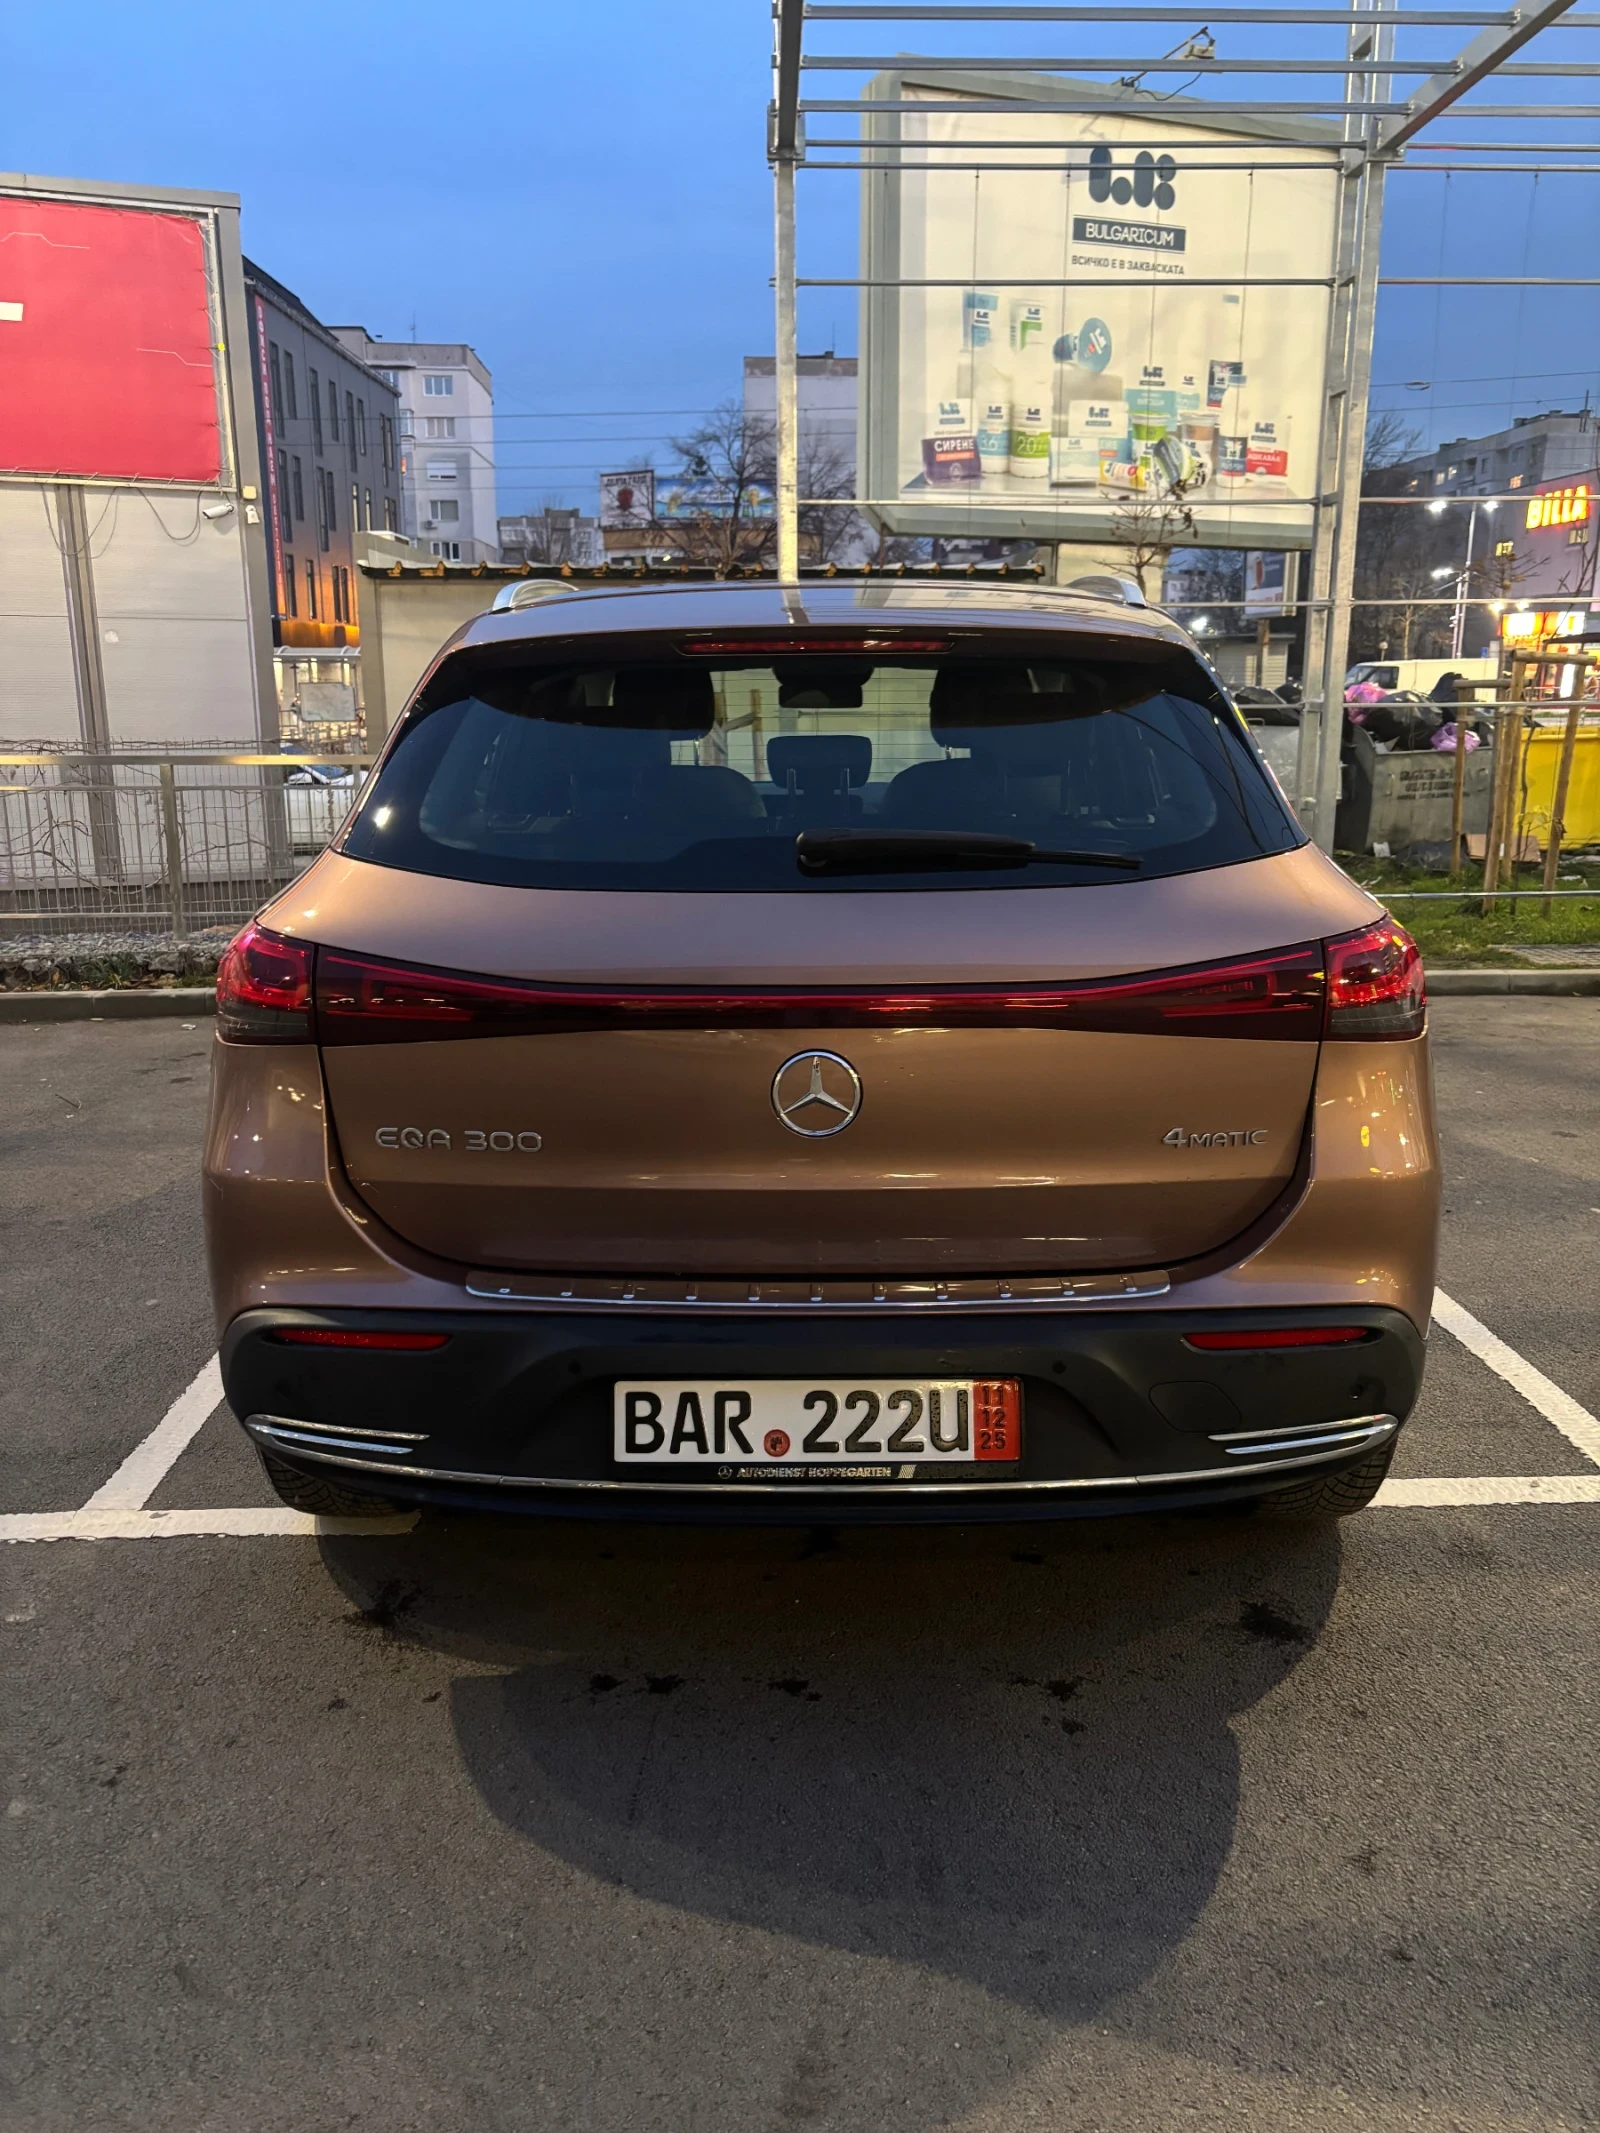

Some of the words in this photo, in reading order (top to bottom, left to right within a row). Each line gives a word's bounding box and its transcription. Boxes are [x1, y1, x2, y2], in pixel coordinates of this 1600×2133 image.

[1085, 222, 1175, 247] BULGARICUM
[1071, 255, 1110, 268] ВСИЧКО
[1127, 260, 1185, 275] ЗАКВАСКАТА
[933, 438, 975, 452] СИРЕНЕ
[1525, 484, 1589, 529] BILLA
[374, 1127, 453, 1151] EQA
[464, 1130, 543, 1153] 300
[1162, 1126, 1269, 1149] 4MATIC
[981, 1384, 1004, 1405] 11
[625, 1390, 754, 1455] BAR
[802, 1389, 970, 1454] 222U
[981, 1407, 1006, 1428] 12
[980, 1431, 1006, 1450] 25
[736, 1466, 805, 1479] AUTODIENST
[808, 1466, 892, 1478] HOPPEGARTEN
